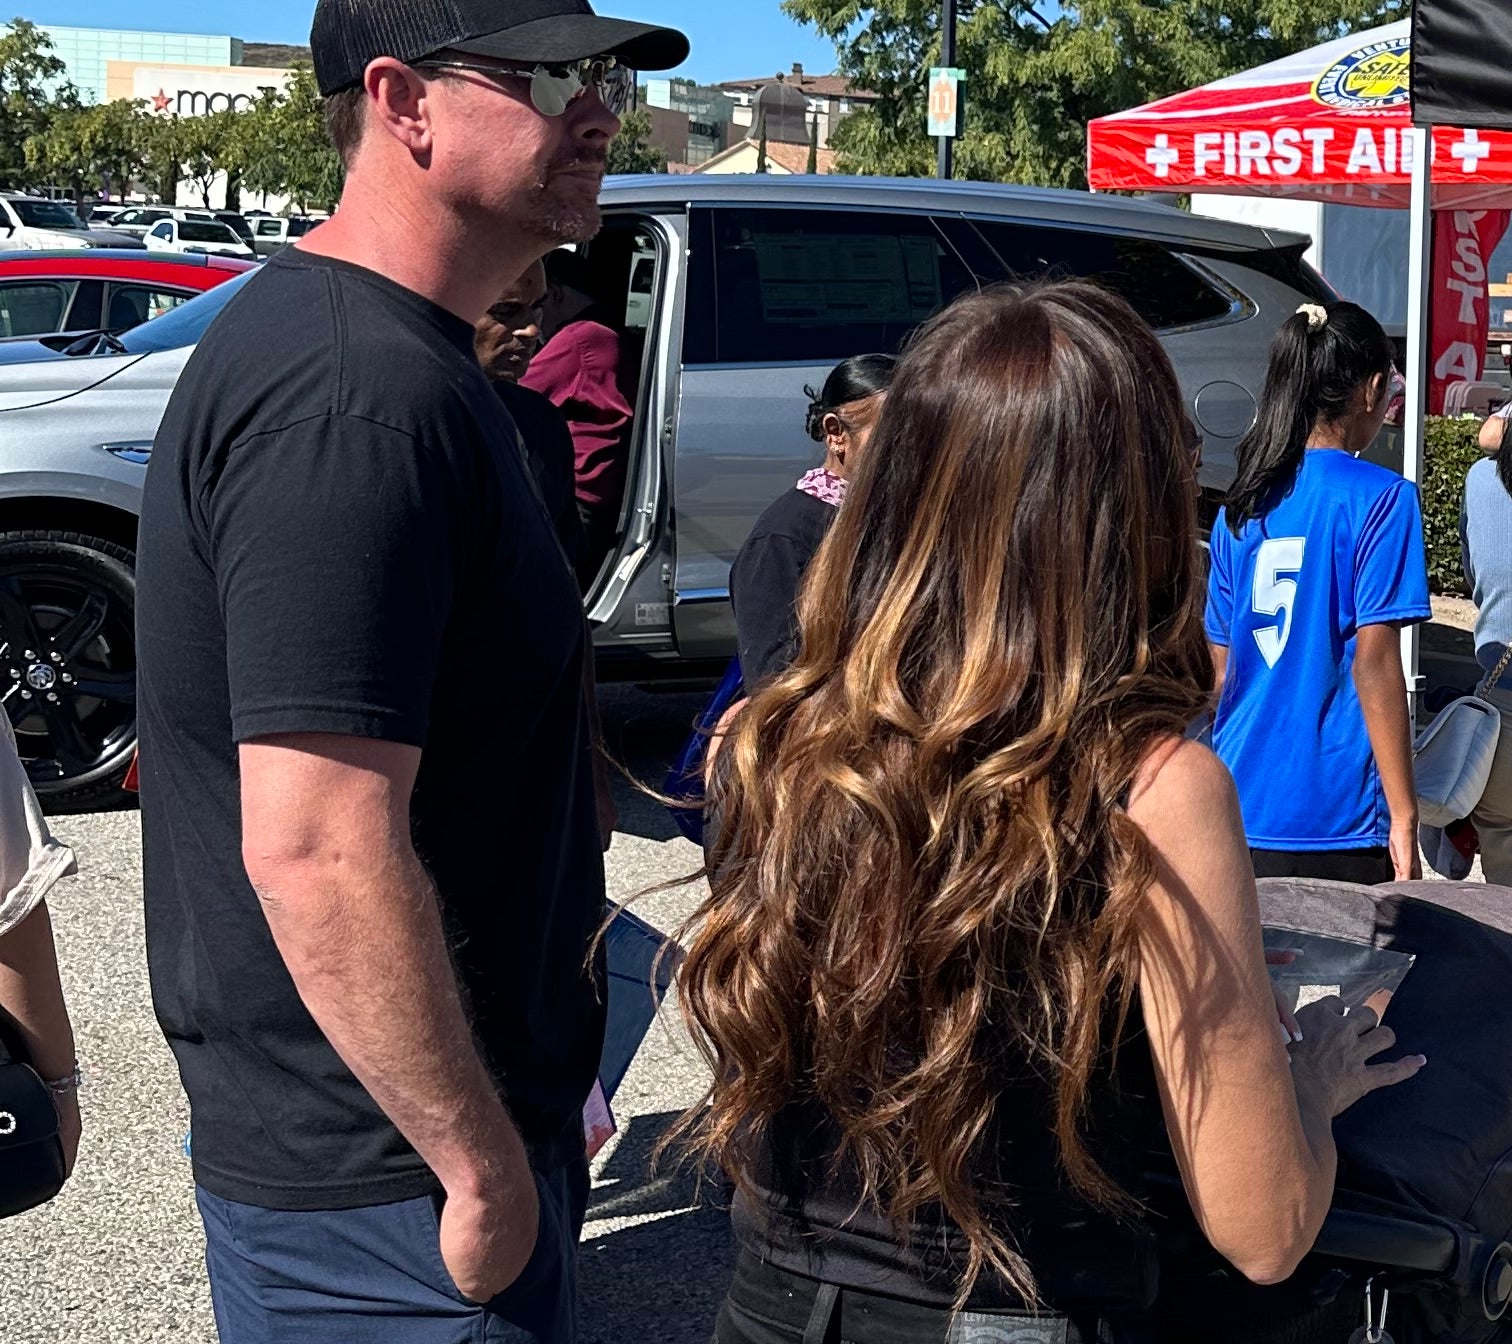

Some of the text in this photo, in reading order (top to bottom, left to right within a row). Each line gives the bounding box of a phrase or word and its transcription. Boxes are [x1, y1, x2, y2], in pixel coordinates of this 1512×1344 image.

[933, 90, 951, 114] 11
[1193, 127, 1335, 177] FIRST
[1252, 537, 1307, 670] 5
